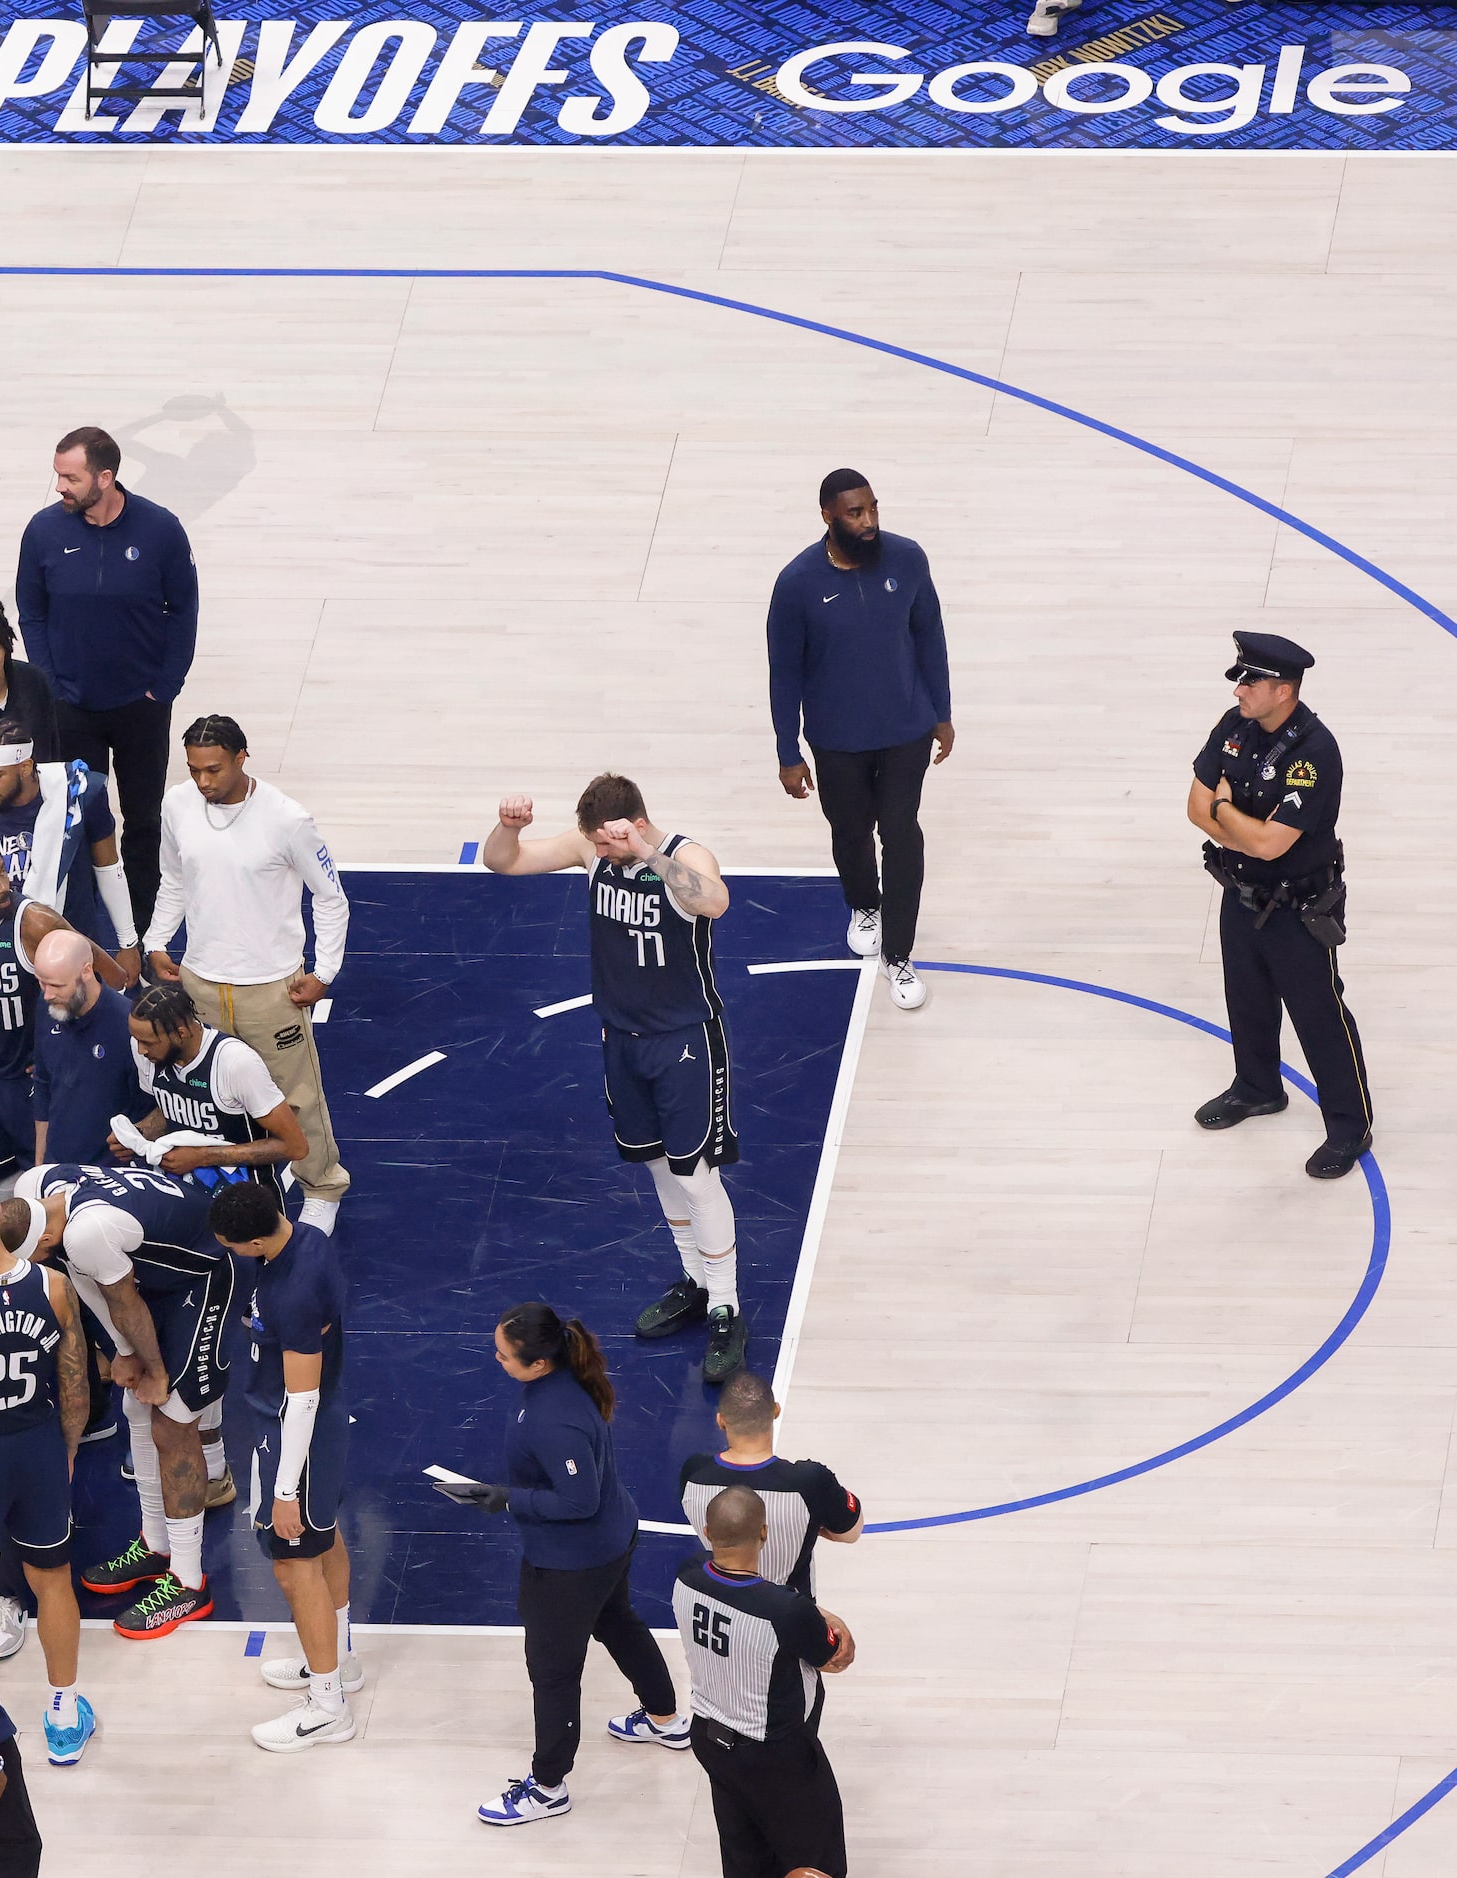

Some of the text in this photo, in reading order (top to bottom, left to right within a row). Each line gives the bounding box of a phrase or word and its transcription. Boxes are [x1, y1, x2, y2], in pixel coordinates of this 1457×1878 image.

[1067, 13, 1186, 64] NOWITZKI
[776, 41, 1412, 134] Google
[1285, 760, 1318, 781] DALLAS POLICE
[1285, 777, 1316, 788] DEPARTMENT
[628, 928, 666, 967] 77
[188, 1078, 207, 1088] chime
[692, 1602, 732, 1658] 25
